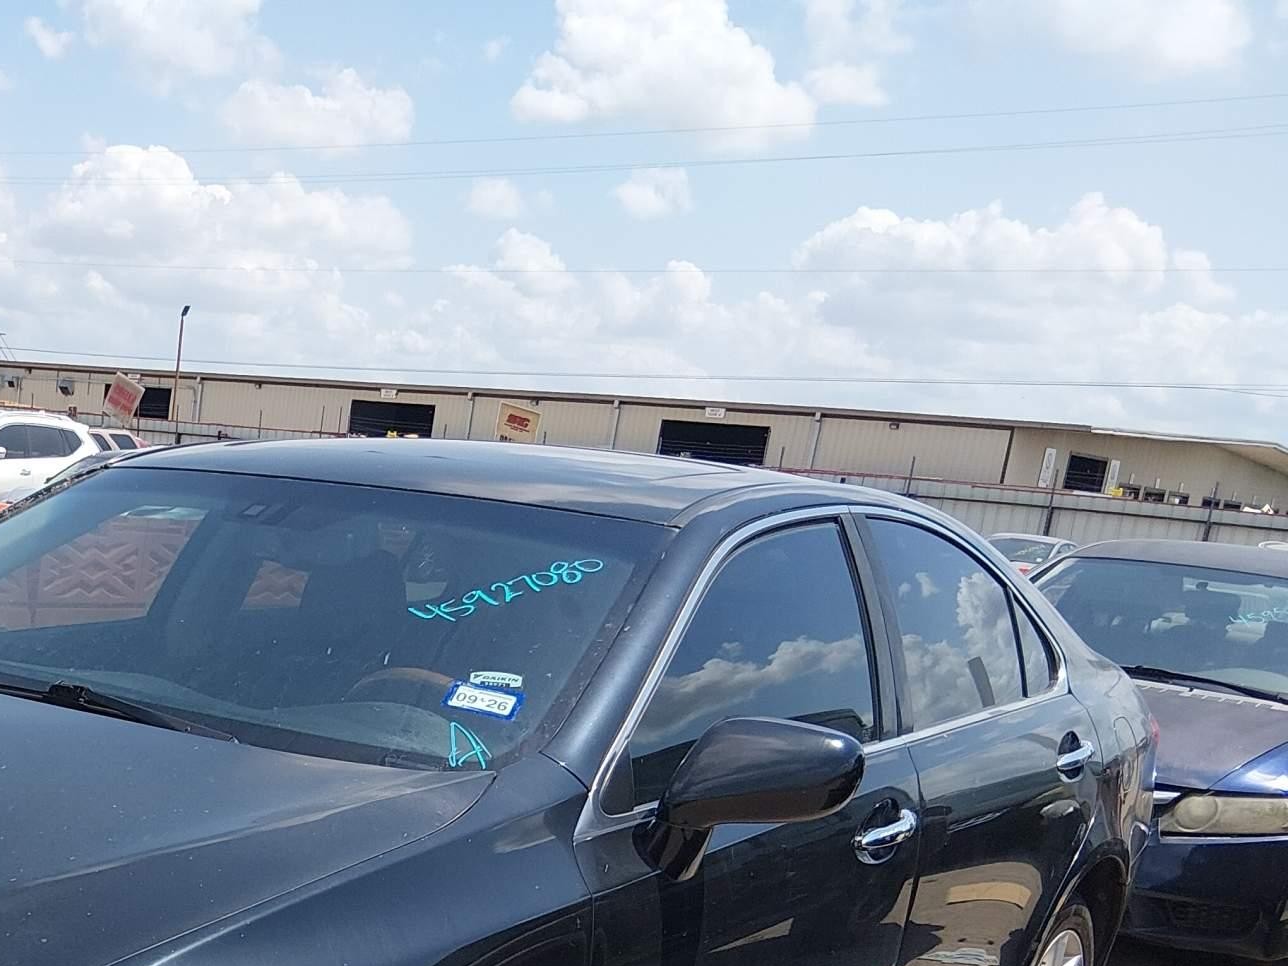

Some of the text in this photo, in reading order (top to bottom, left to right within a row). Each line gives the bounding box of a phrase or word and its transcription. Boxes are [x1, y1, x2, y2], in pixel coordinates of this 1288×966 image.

[408, 558, 604, 622] 45927080
[455, 692, 510, 712] 09 26
